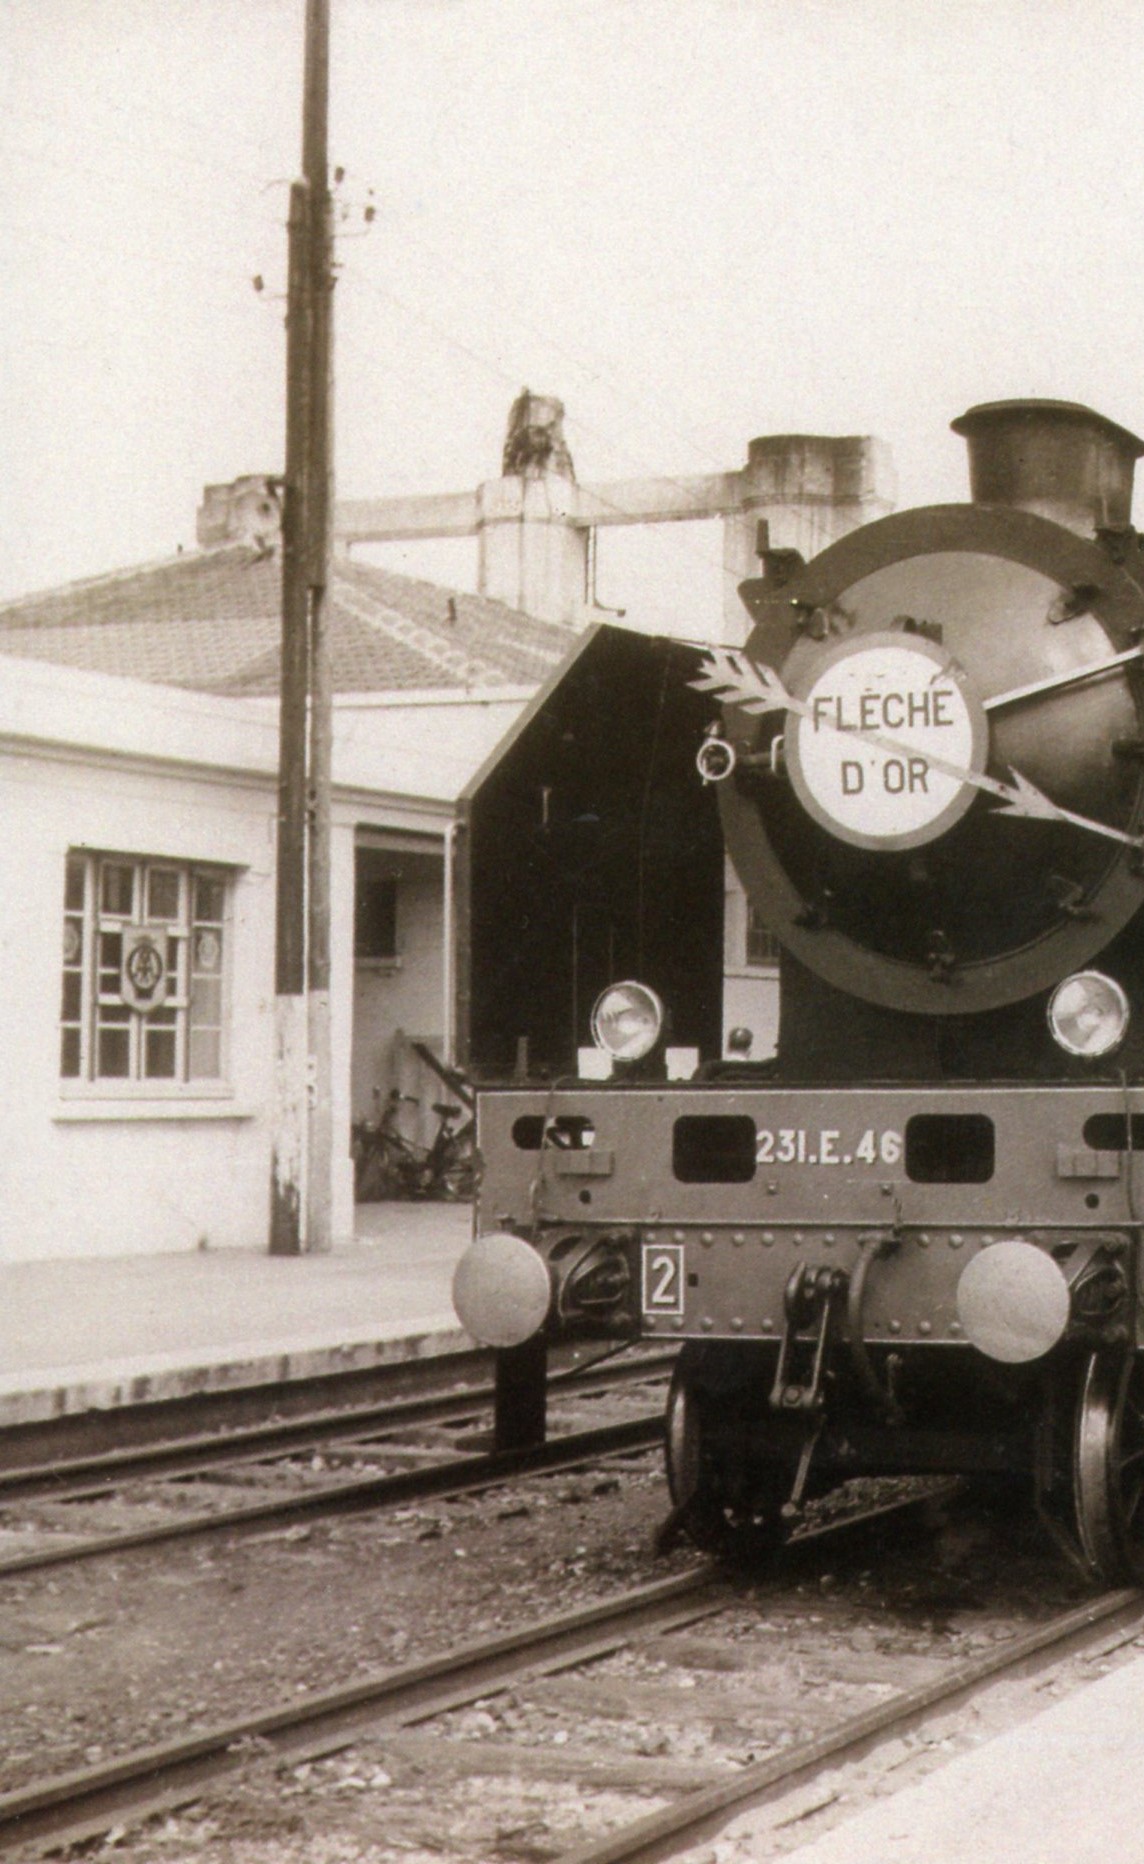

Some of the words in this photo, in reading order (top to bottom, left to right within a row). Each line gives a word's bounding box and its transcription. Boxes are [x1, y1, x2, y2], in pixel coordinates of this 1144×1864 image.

[841, 757, 929, 795] D'OR
[756, 1130, 902, 1164] 231.E.46
[652, 1255, 675, 1303] 2
